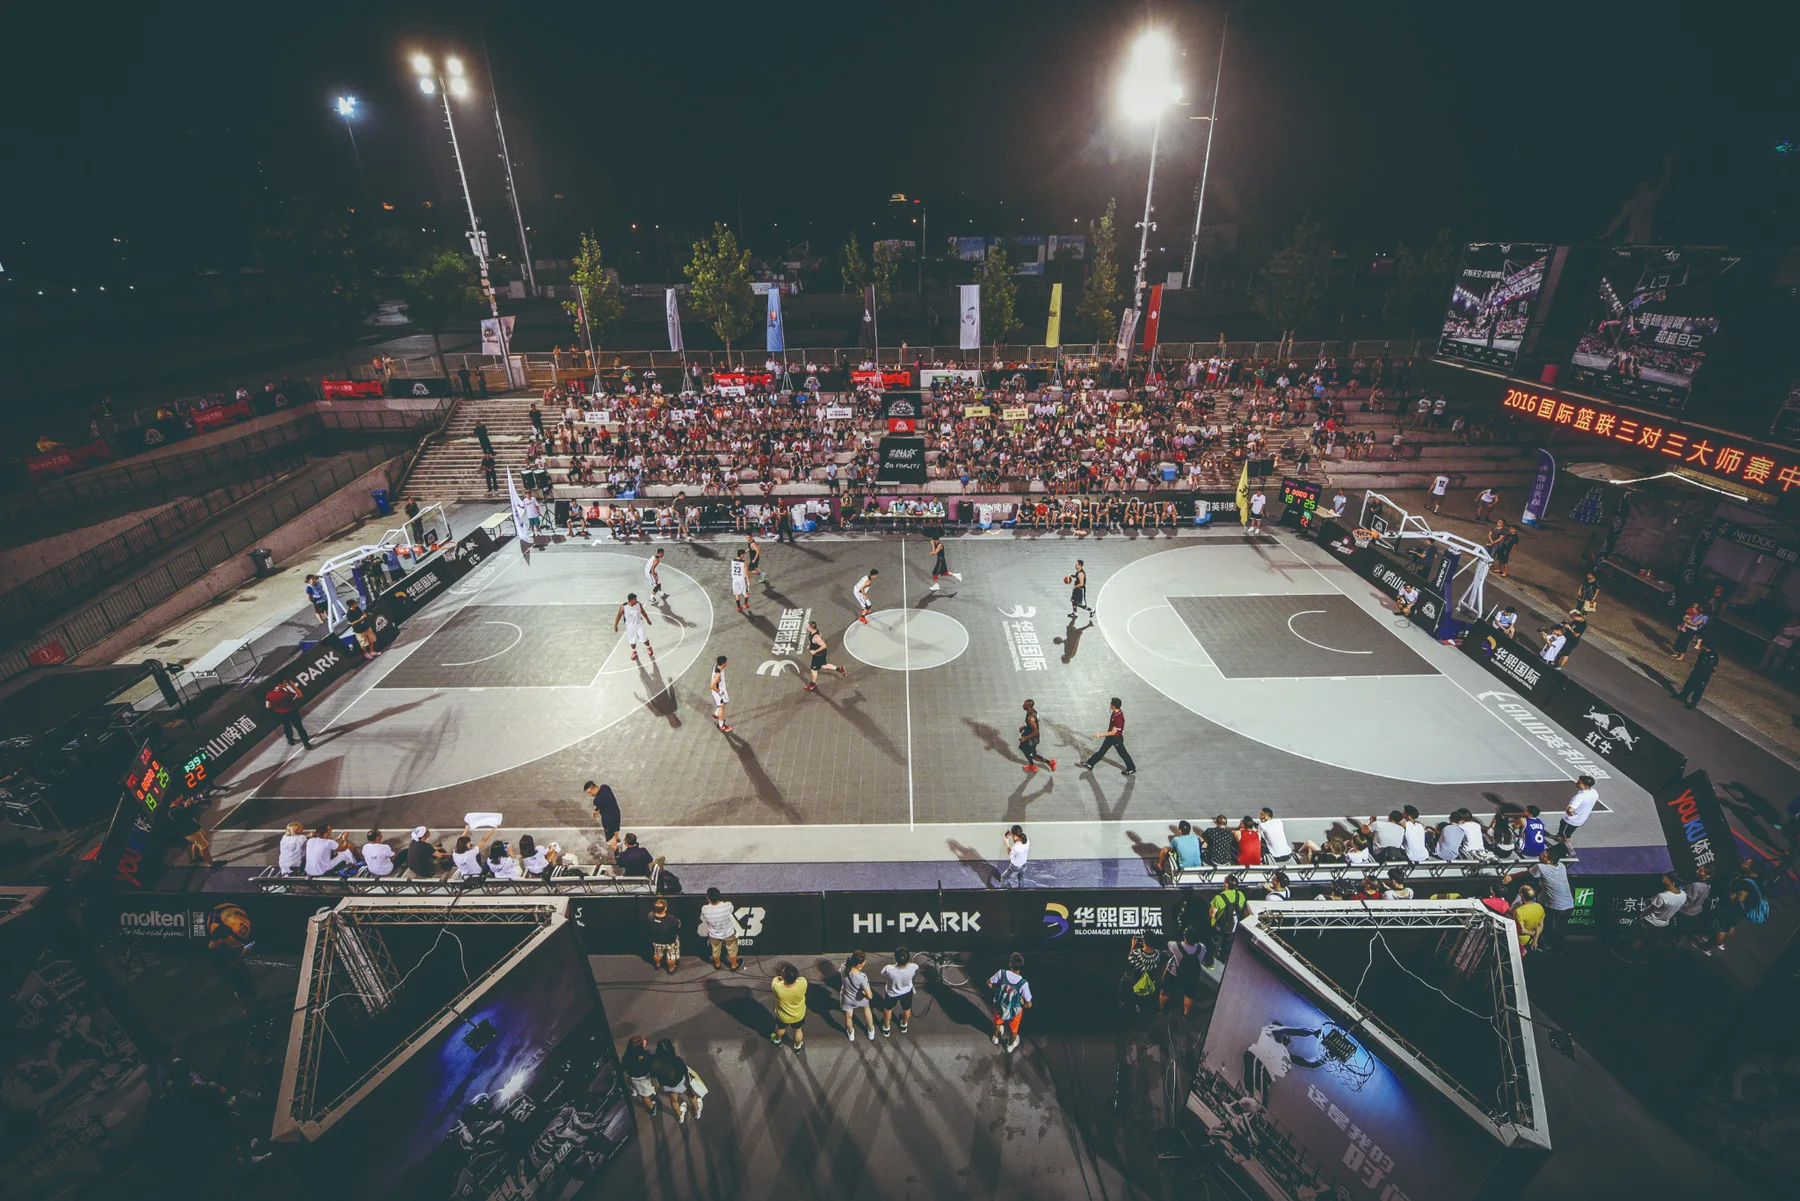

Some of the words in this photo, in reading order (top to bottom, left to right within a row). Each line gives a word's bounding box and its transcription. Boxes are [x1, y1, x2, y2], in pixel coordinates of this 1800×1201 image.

[1640, 312, 1687, 330] 超越极限
[1654, 330, 1703, 348] 超越自己
[1303, 499, 1315, 510] 25
[1300, 515, 1309, 527] 22
[733, 566, 742, 574] 23
[406, 571, 439, 597] 华熙国际
[772, 607, 804, 656] 华熙国际
[1011, 620, 1048, 671] 华熙国际
[1494, 646, 1541, 686] 华熙国际
[200, 714, 258, 762] 山啤酒
[1584, 731, 1613, 755] 红牛
[184, 764, 207, 788] 22
[145, 792, 158, 811] 19
[156, 766, 170, 788] 25
[1534, 830, 1544, 844] 6
[1668, 788, 1701, 843] YOUKU
[1690, 838, 1715, 867] 体育
[120, 911, 185, 927] molten
[853, 911, 982, 933] HI-PARK
[1073, 906, 1163, 928] 华熙国际
[1567, 917, 1591, 925] oliday
[133, 928, 145, 936] the
[146, 928, 163, 936] real
[1307, 1083, 1395, 1174] 这是我的
